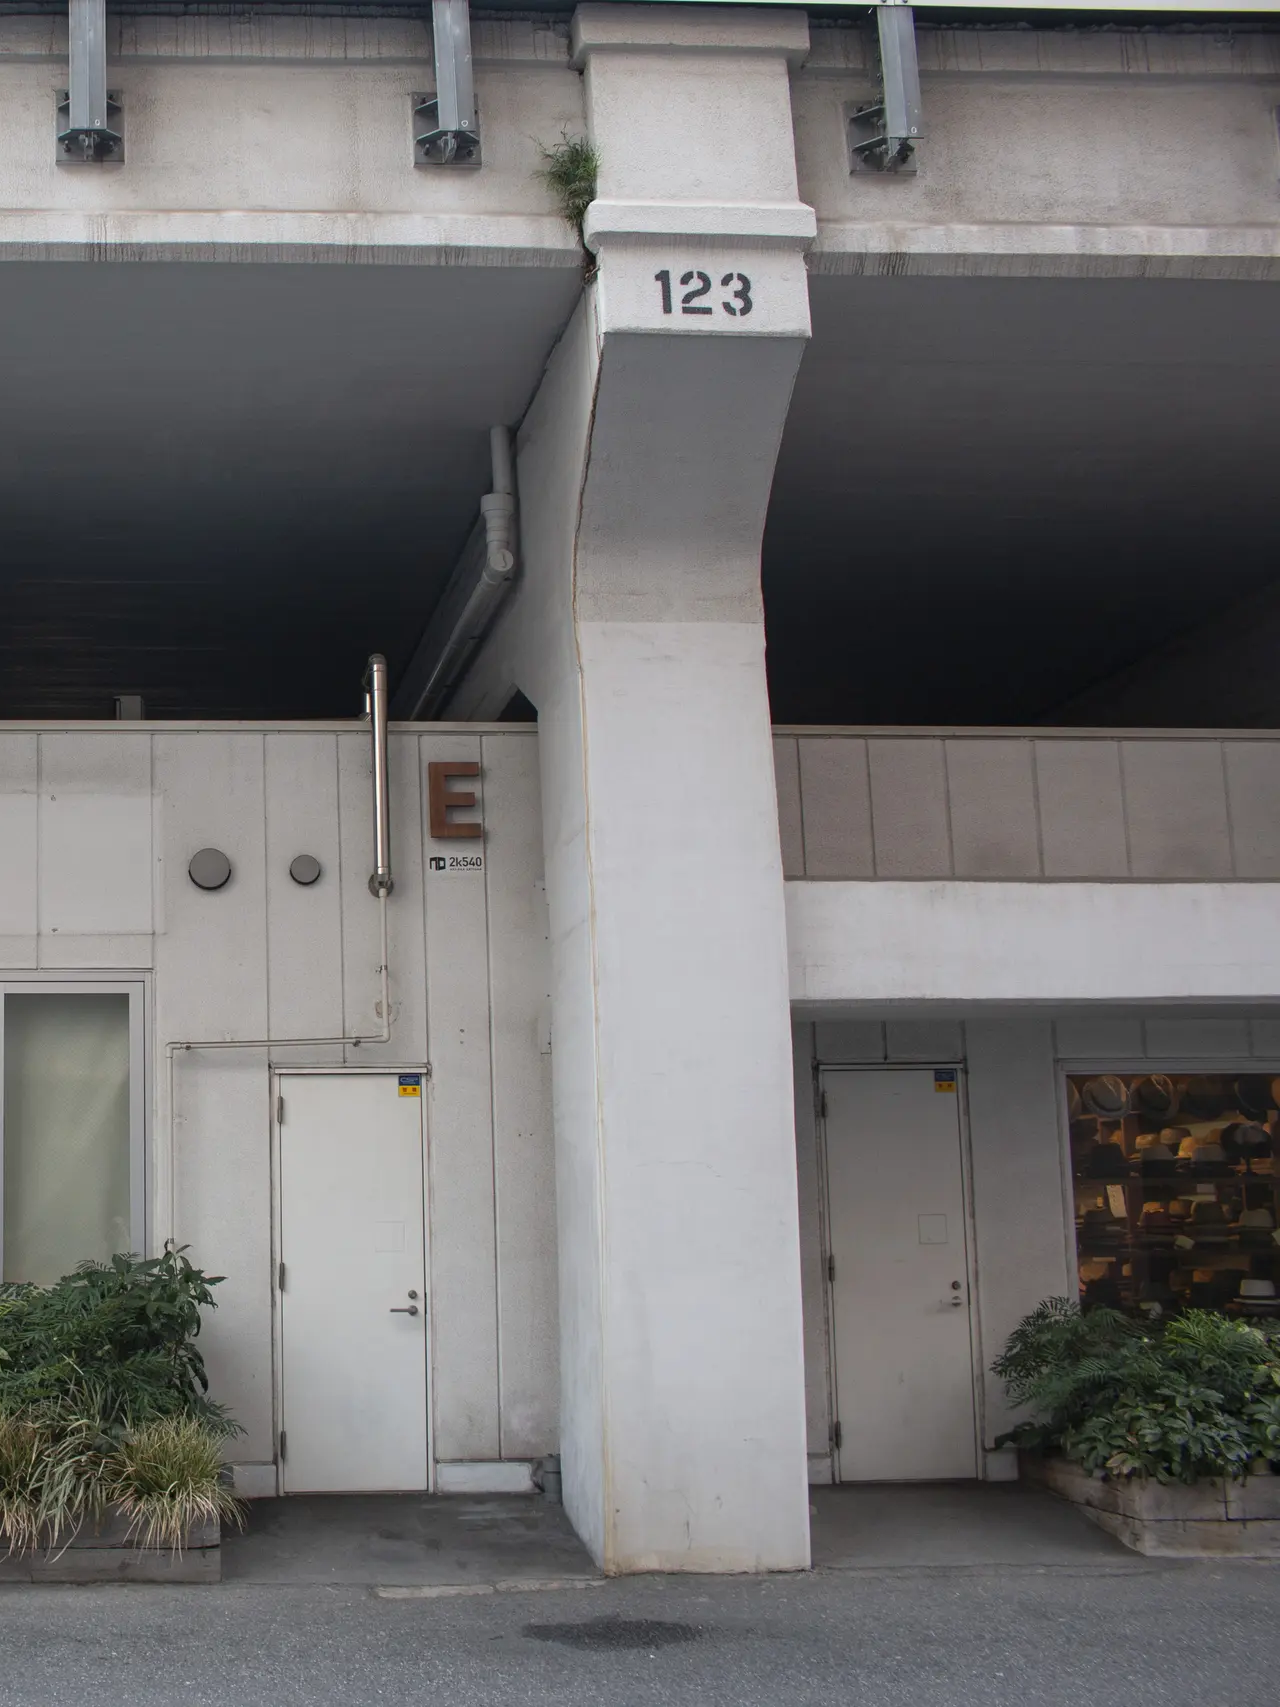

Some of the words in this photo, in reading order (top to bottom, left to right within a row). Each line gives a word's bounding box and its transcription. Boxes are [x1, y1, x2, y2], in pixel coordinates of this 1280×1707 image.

[654, 270, 753, 316] 123
[428, 762, 482, 838] E
[449, 856, 482, 867] 2k540
